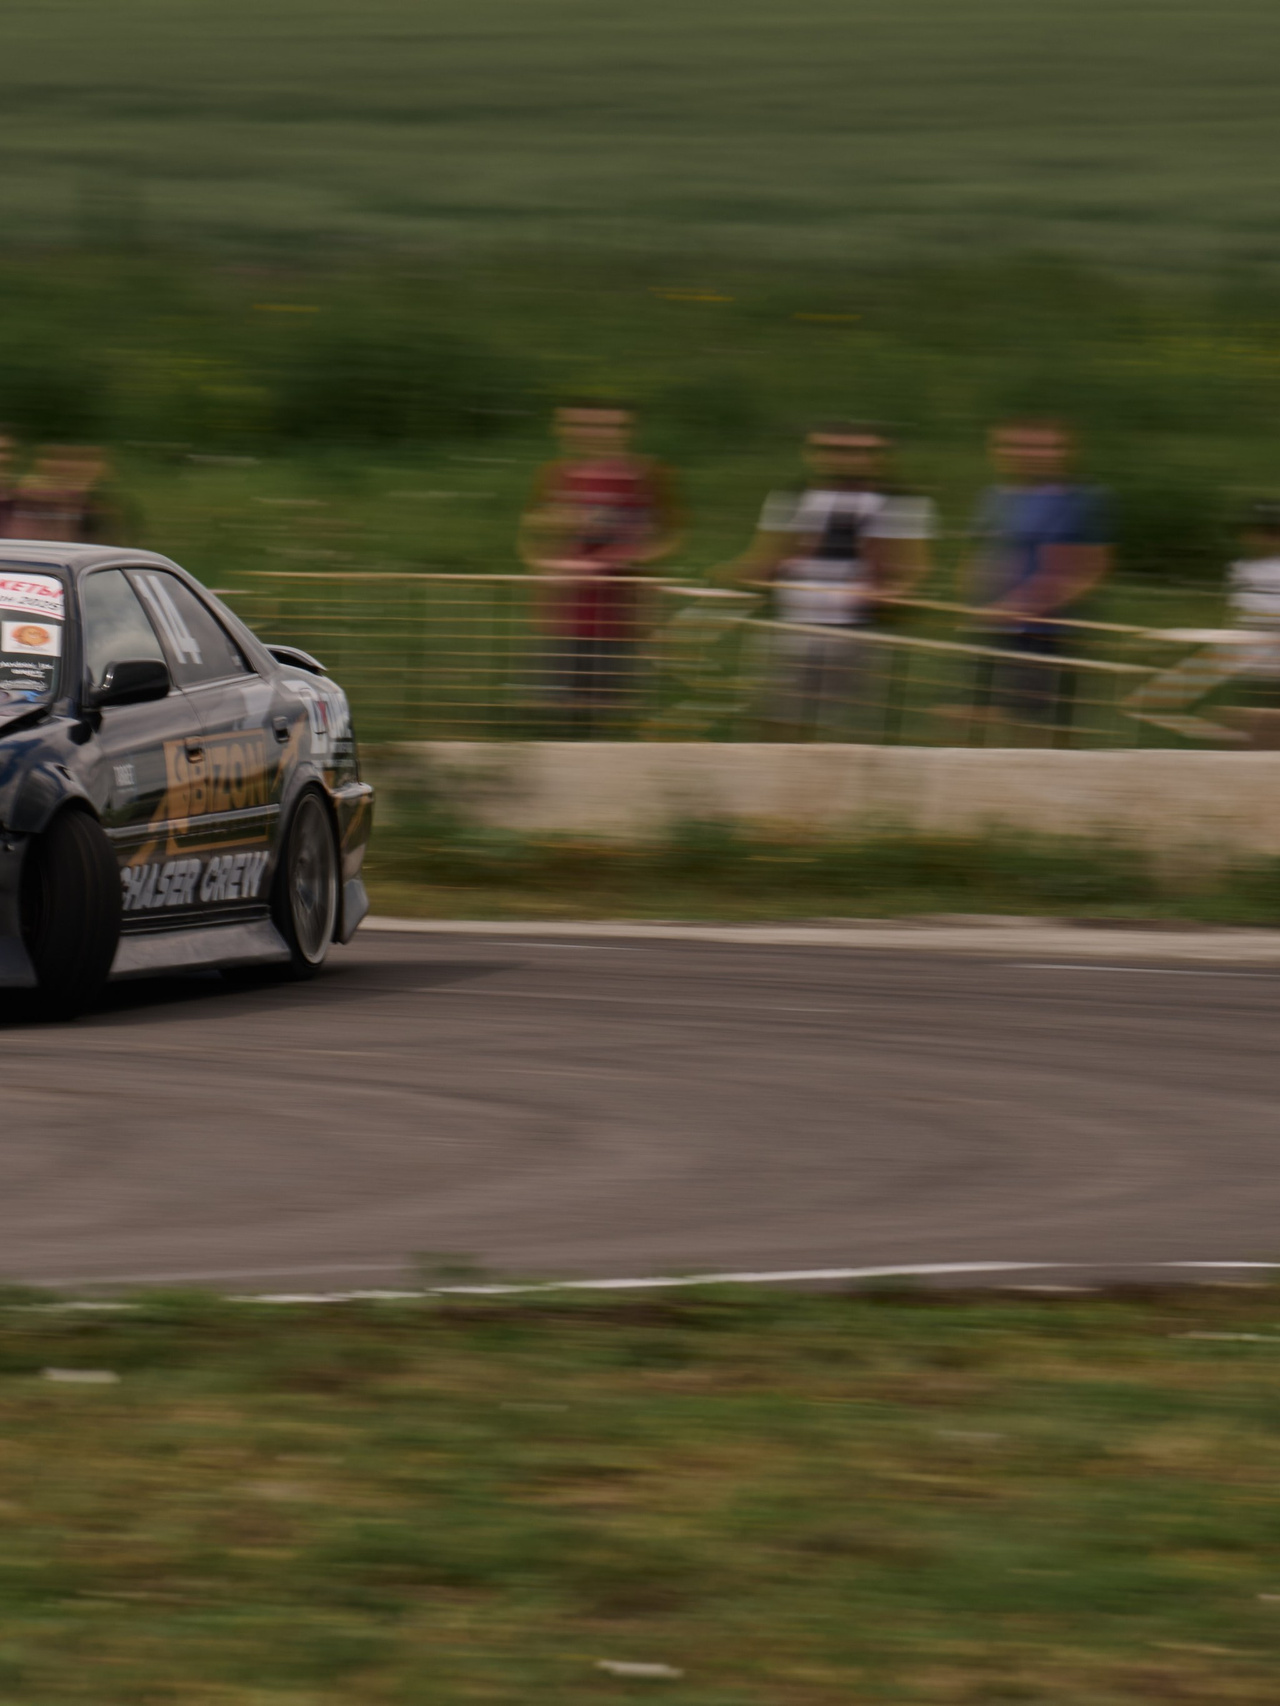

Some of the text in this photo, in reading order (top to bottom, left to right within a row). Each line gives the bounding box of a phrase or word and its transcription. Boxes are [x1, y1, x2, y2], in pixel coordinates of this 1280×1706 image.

[133, 574, 203, 665] 14
[189, 742, 267, 817] BIZON
[200, 851, 270, 901] CREW
